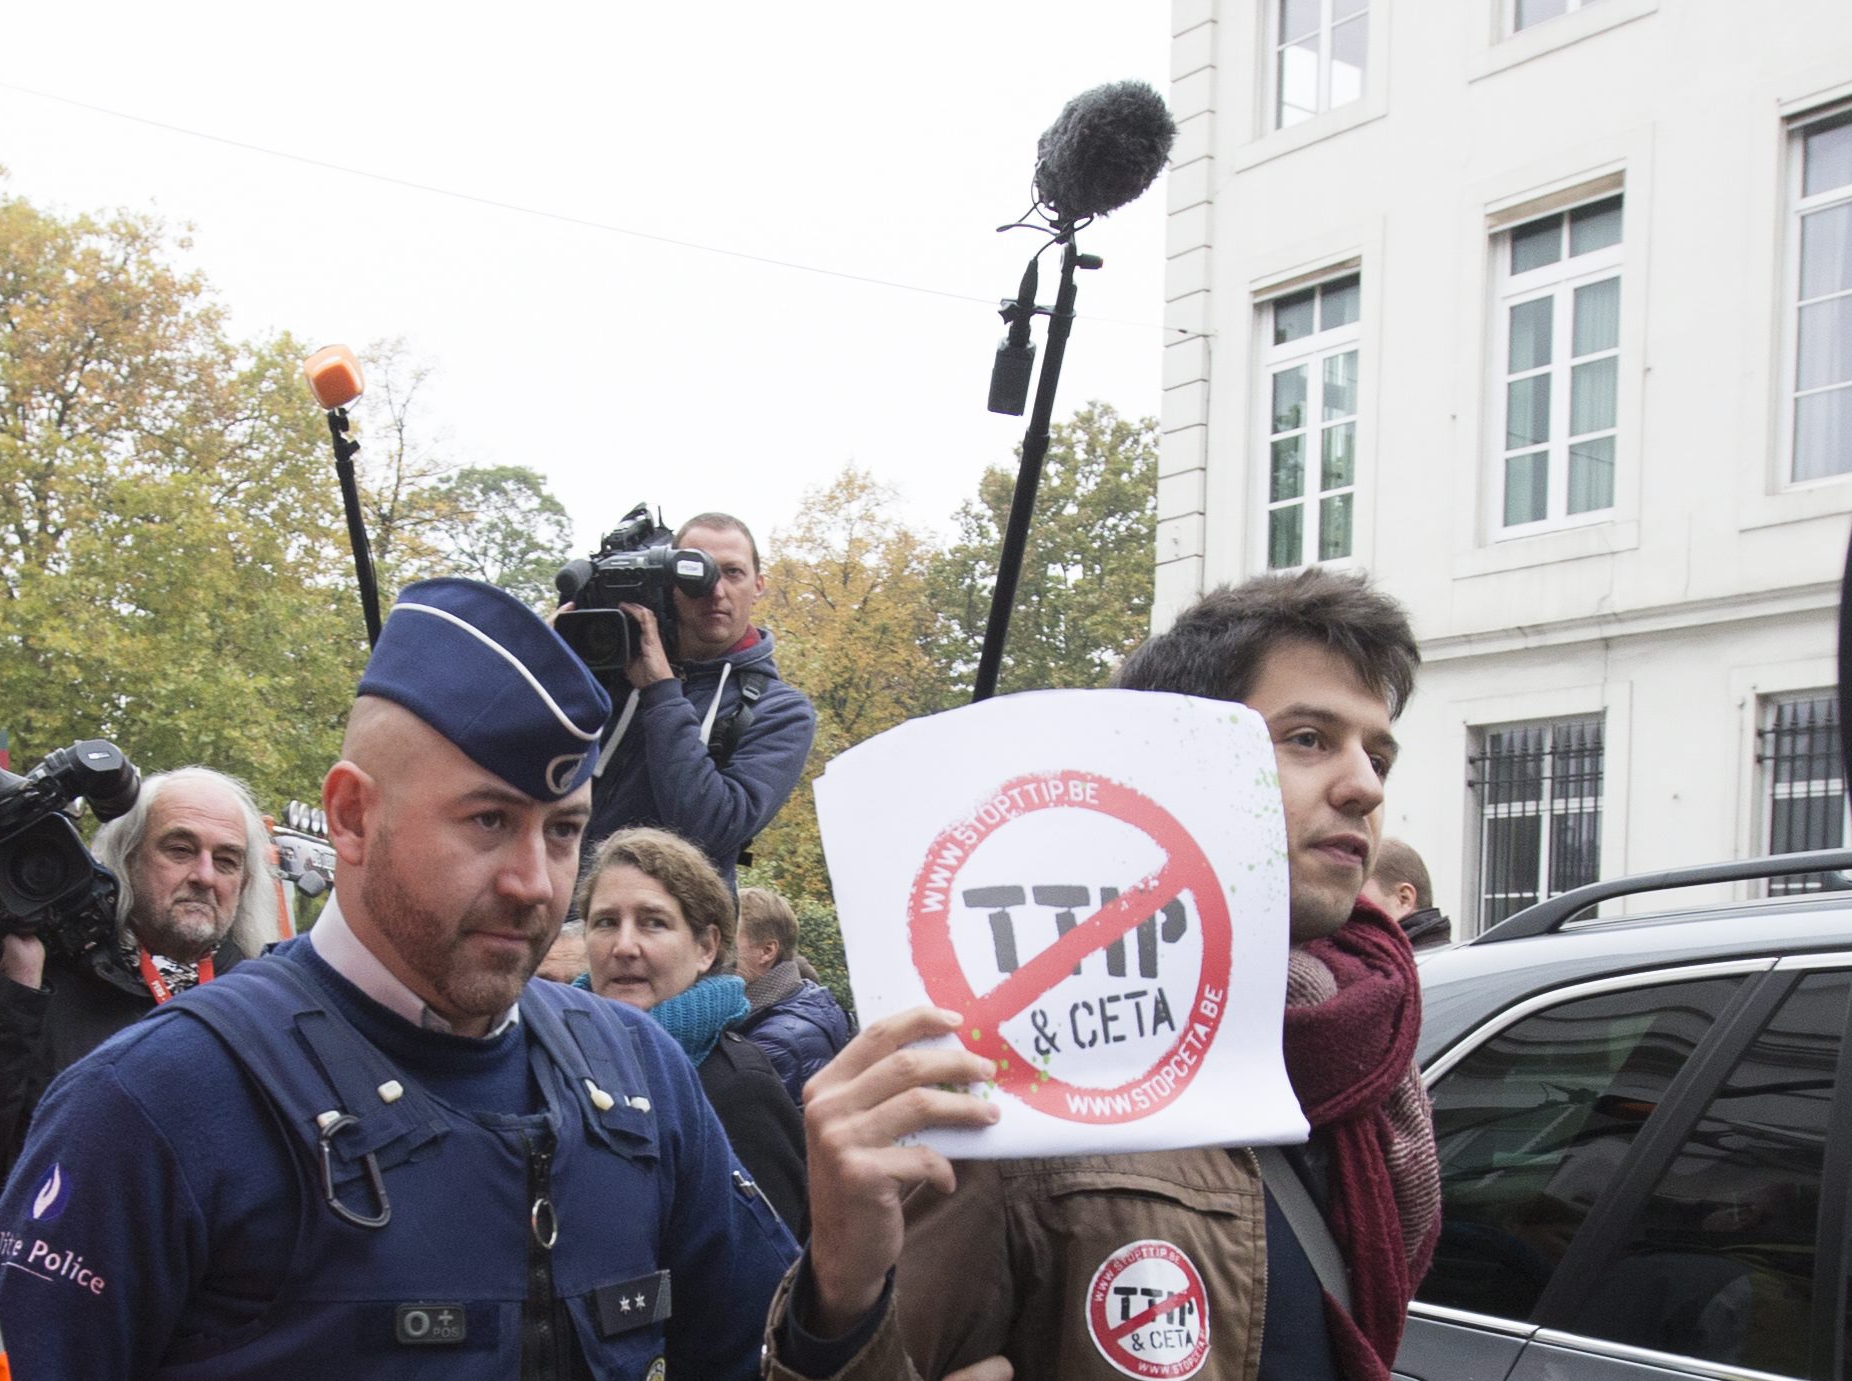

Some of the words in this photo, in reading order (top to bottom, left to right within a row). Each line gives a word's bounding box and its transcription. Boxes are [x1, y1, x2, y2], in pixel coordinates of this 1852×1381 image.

[920, 780, 1098, 914] WWW.STOPTTIP.BE
[962, 885, 1187, 979] TTIP
[1031, 1008, 1061, 1057] &
[1069, 987, 1175, 1050] CETA
[1066, 984, 1223, 1116] WWW.STOPCETA.BE
[28, 1239, 105, 1294] Police
[1131, 1333, 1146, 1352] &
[1150, 1329, 1195, 1349] CETA
